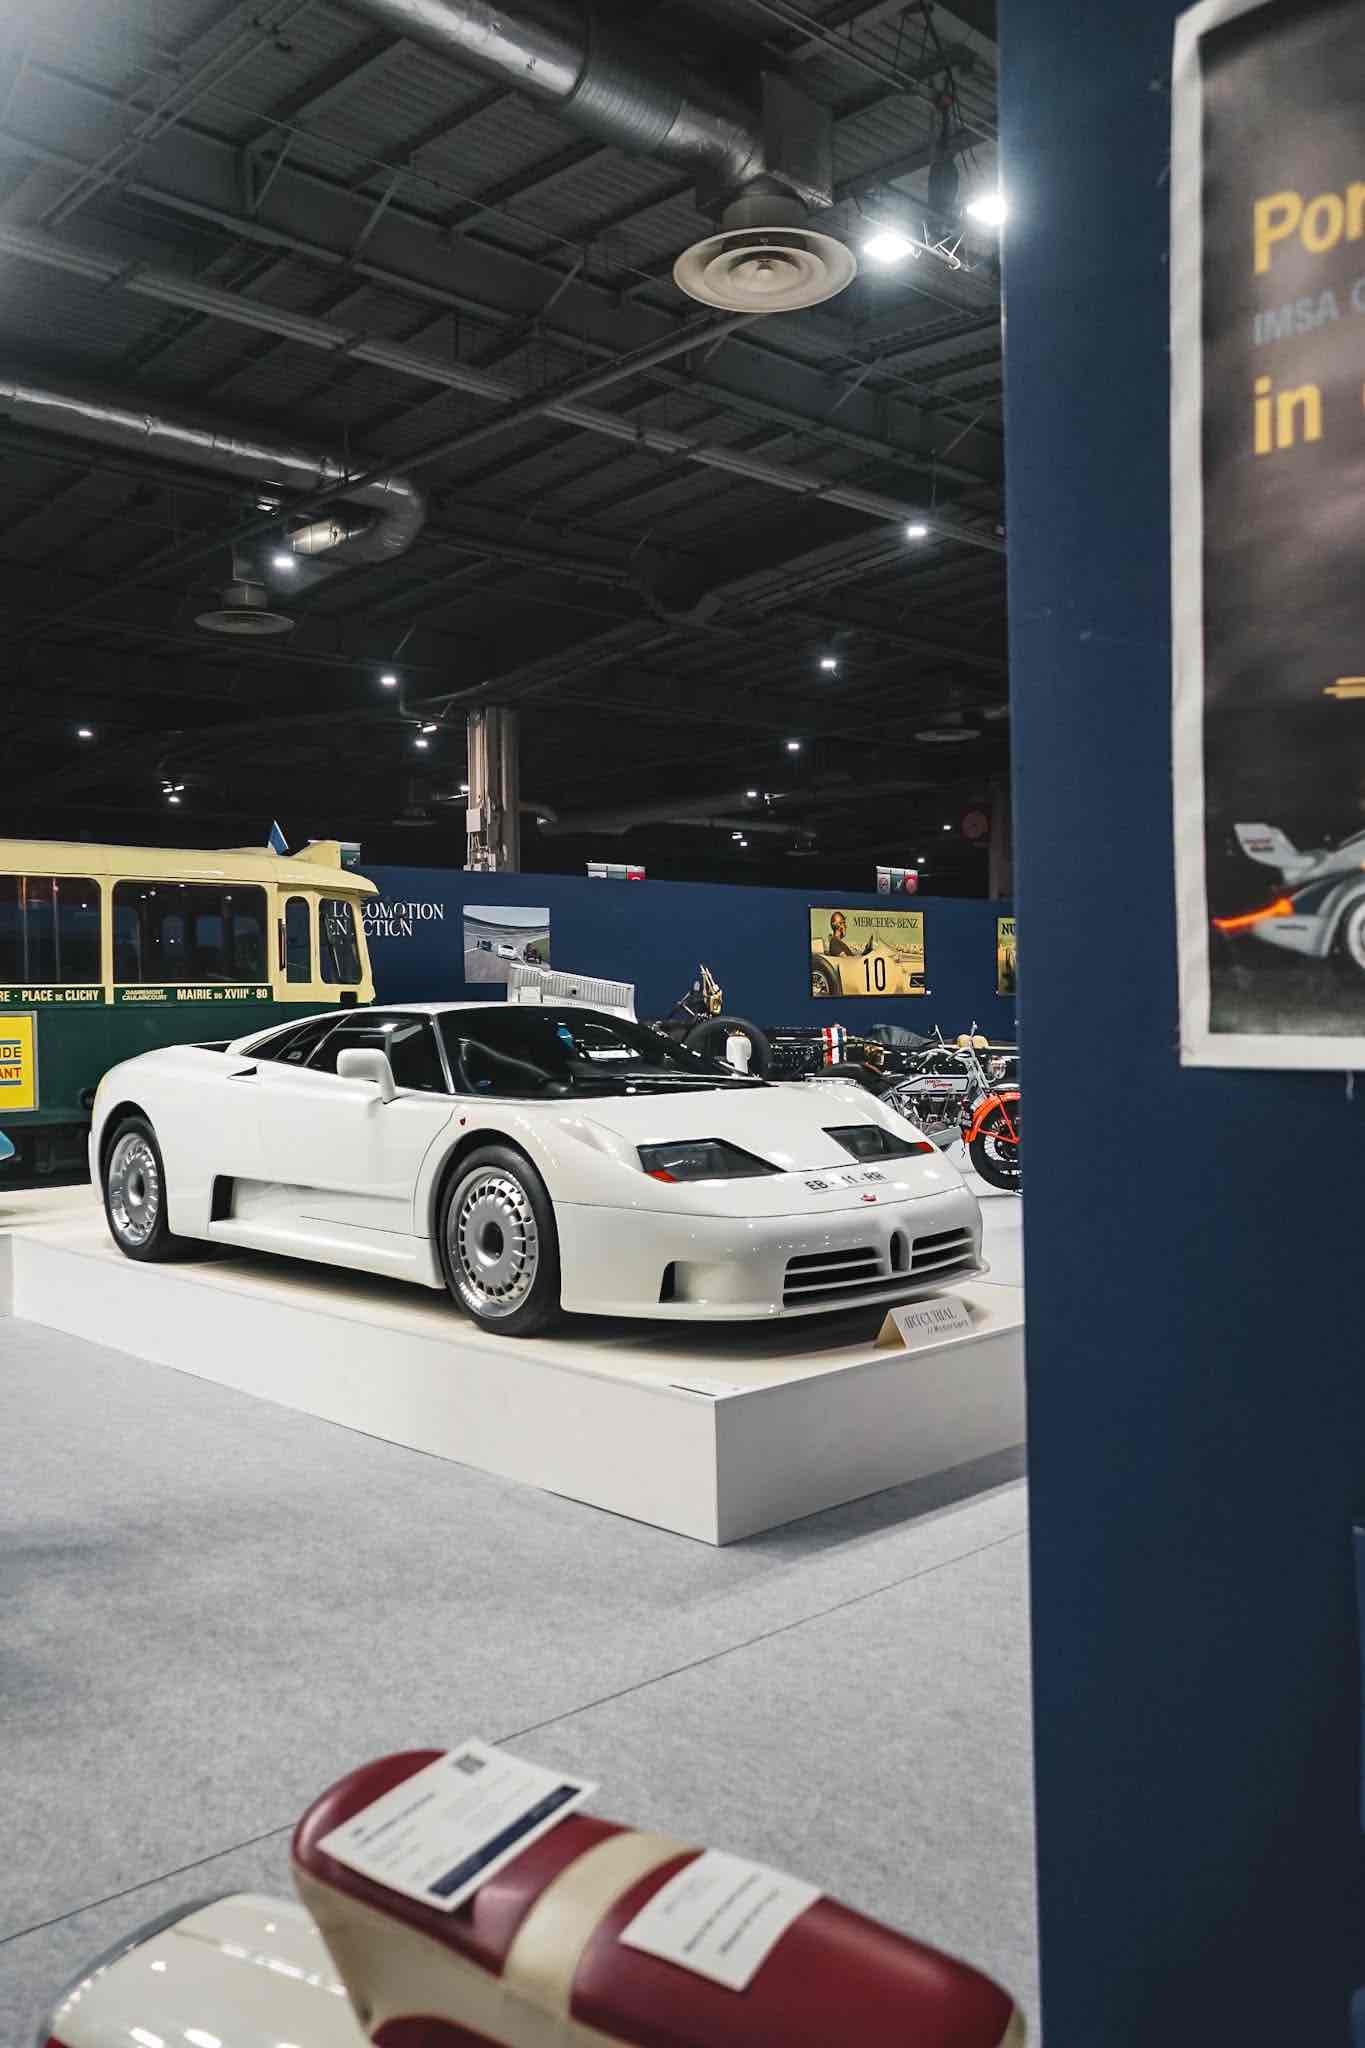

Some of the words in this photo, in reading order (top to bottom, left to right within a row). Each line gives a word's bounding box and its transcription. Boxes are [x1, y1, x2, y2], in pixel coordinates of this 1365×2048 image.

[1253, 289, 1338, 345] IMSA
[1254, 376, 1321, 455] in
[333, 901, 444, 919] LOOMOTION
[352, 920, 414, 936] CTION
[853, 916, 919, 929] MERCEDES-BENZ
[864, 957, 886, 992] 10
[21, 990, 53, 1001] PLACE
[64, 989, 99, 1001] CLICHY
[176, 988, 212, 1000] MAIRIE
[256, 988, 268, 998] 80
[804, 1179, 829, 1191] EB
